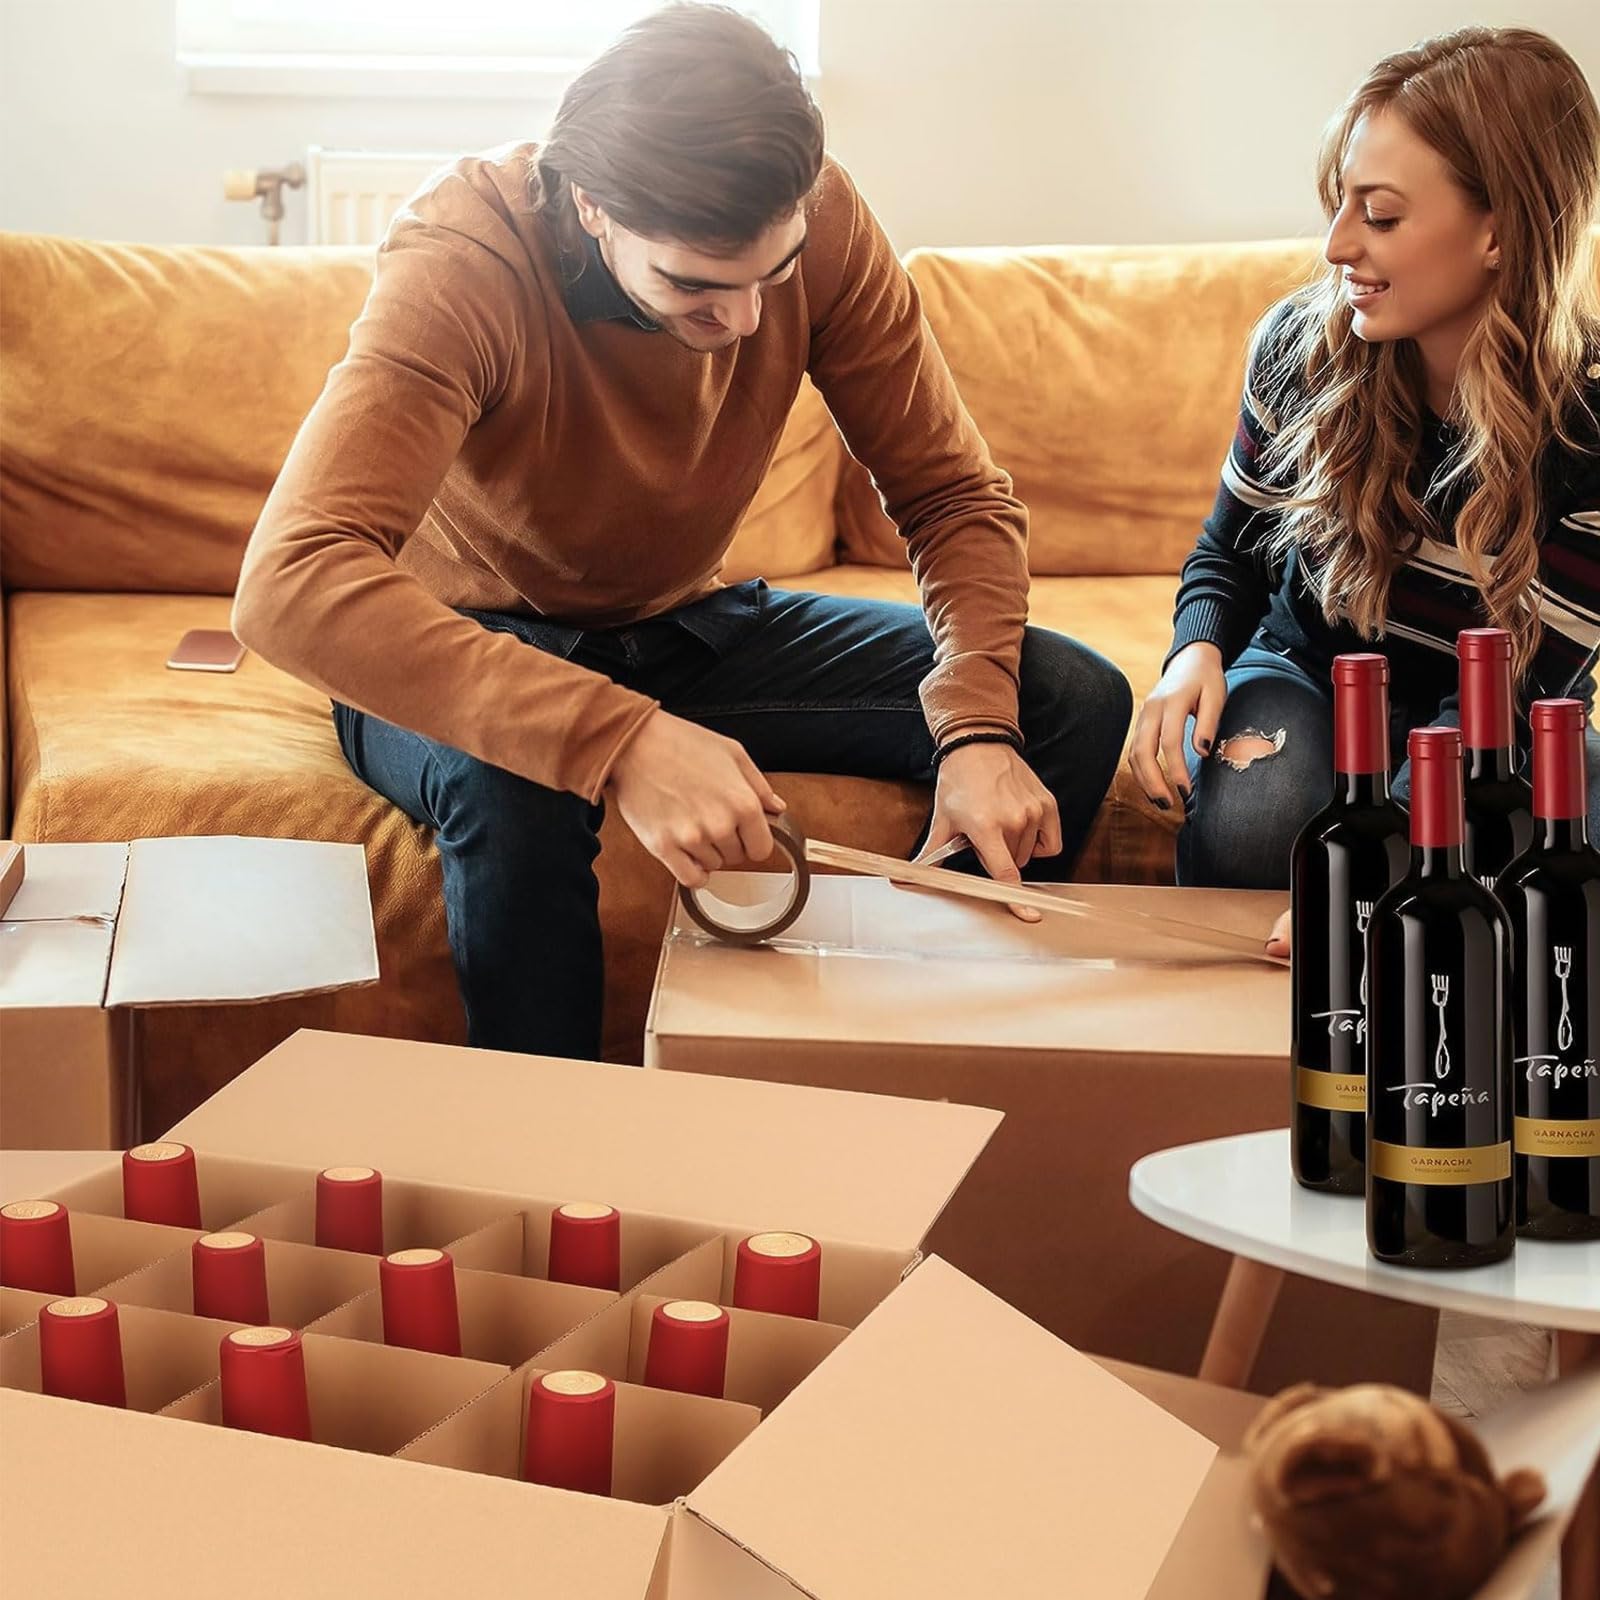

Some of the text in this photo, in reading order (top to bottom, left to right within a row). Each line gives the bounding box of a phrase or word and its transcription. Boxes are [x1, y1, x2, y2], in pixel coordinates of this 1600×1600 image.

[1386, 1083, 1489, 1117] Tapeña
[1534, 1130, 1596, 1138] GARNACHA
[1410, 1157, 1473, 1166] GARNACHA
